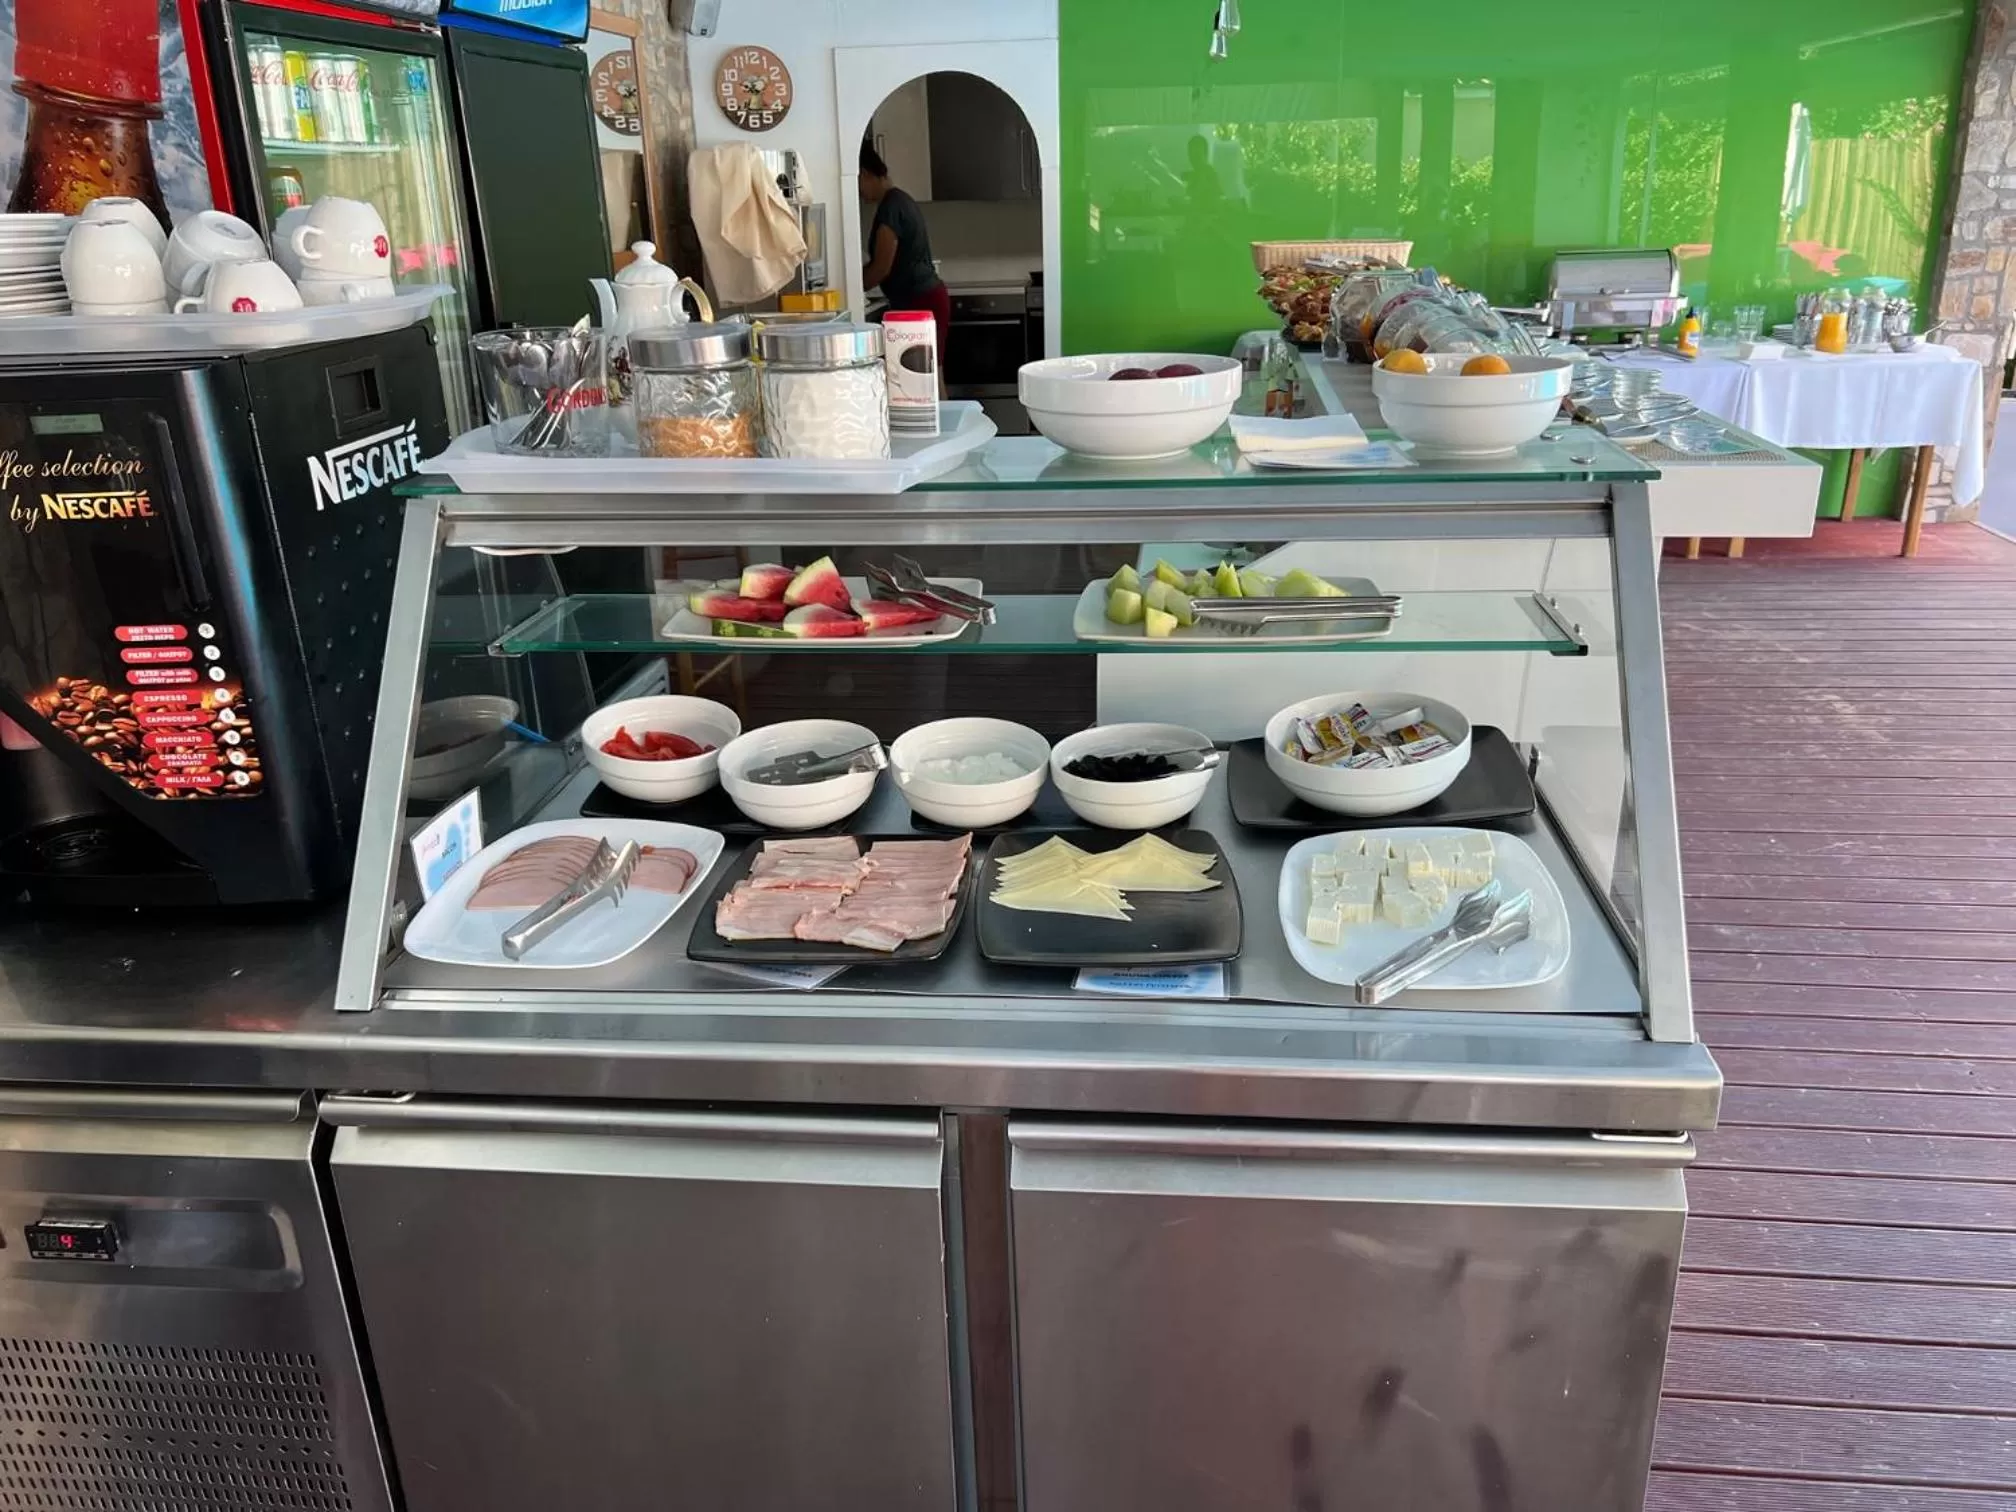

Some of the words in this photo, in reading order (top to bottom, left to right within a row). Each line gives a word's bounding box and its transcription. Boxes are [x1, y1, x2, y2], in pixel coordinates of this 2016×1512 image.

[733, 56, 744, 68] 11
[744, 51, 760, 64] 12
[762, 55, 768, 69] 1
[723, 69, 738, 81] 10
[769, 66, 781, 80] 2
[721, 82, 733, 96] 9
[775, 82, 787, 96] 3
[726, 97, 738, 111] 8
[771, 99, 784, 111] 4
[737, 111, 747, 124] 7
[749, 114, 760, 128] 6
[762, 111, 773, 124] 5
[0, 450, 35, 490] ffee
[41, 449, 144, 478] selection
[307, 418, 422, 511] NESCAFÉ
[10, 494, 39, 533] by
[40, 489, 154, 519] NESCAFÉ
[144, 694, 188, 702] ESPRESSO
[146, 715, 197, 723] CAPPUCCINO
[165, 776, 185, 784] MILK
